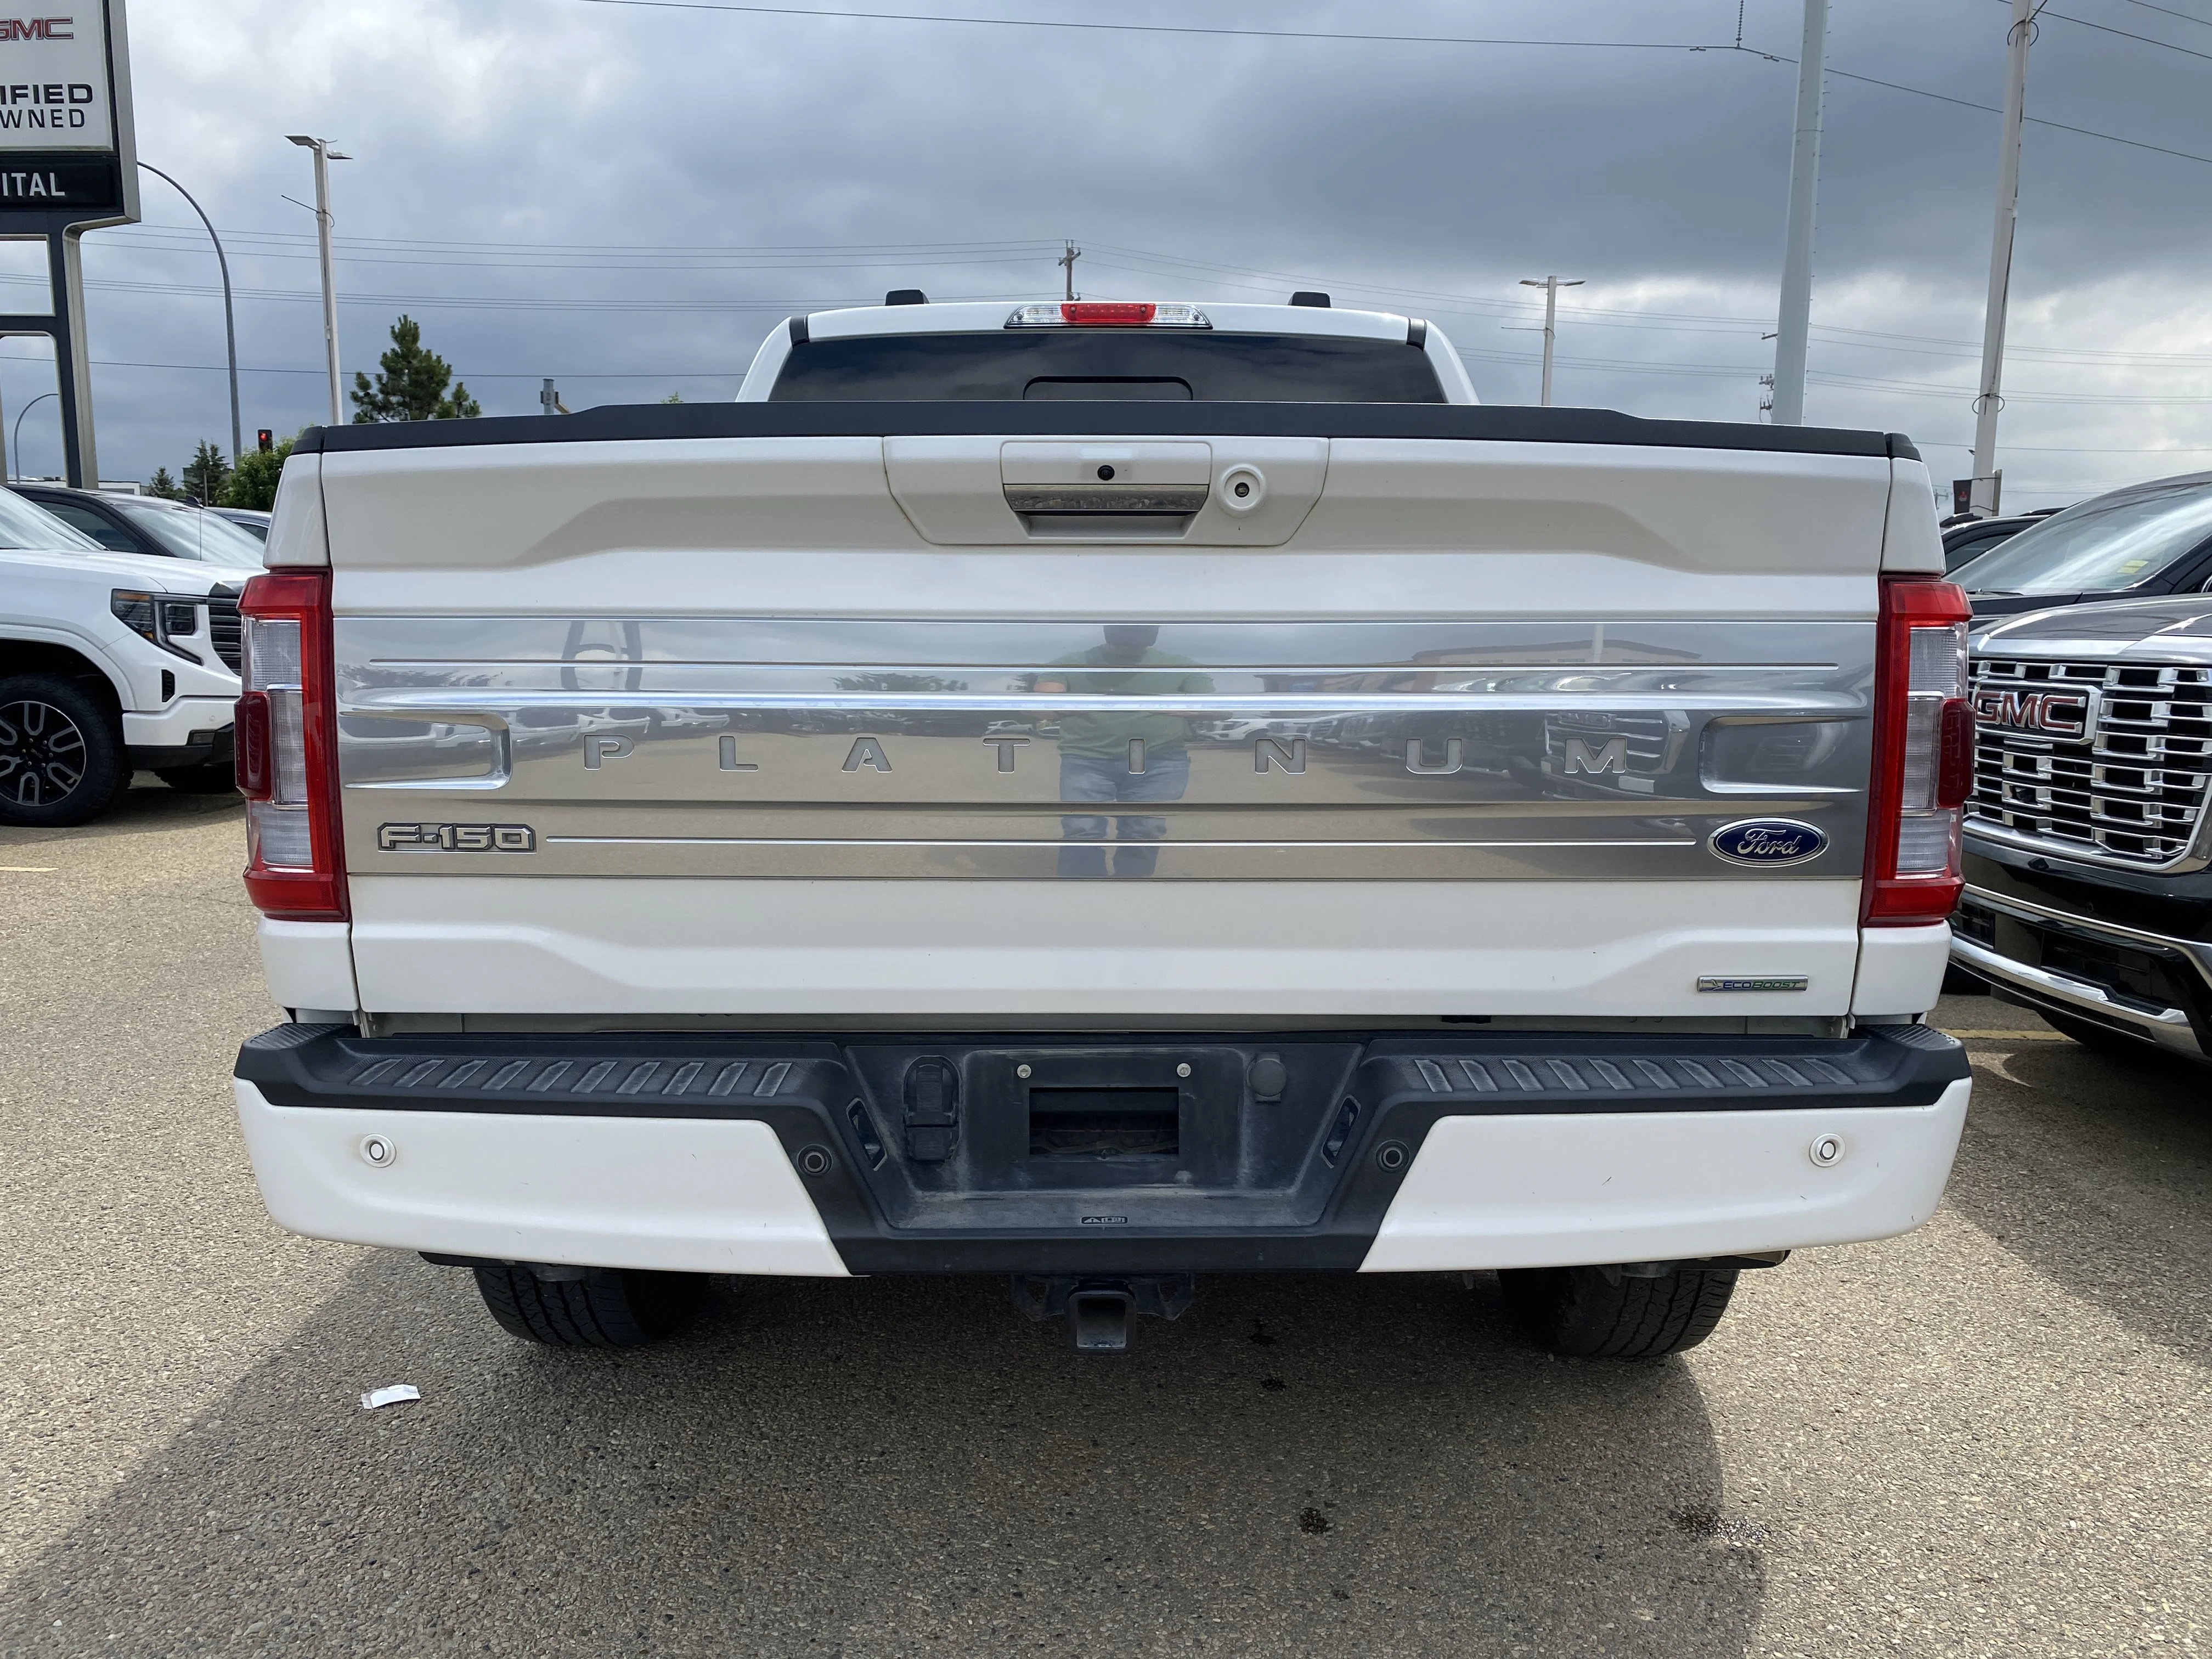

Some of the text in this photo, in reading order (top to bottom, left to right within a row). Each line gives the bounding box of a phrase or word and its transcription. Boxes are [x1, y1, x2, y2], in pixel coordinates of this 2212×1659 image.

[2, 172, 65, 196] ITAL
[1975, 691, 2086, 733] GMC
[583, 733, 1627, 774] PLATINUM
[379, 823, 535, 850] F-150
[1737, 828, 1802, 854] Ford
